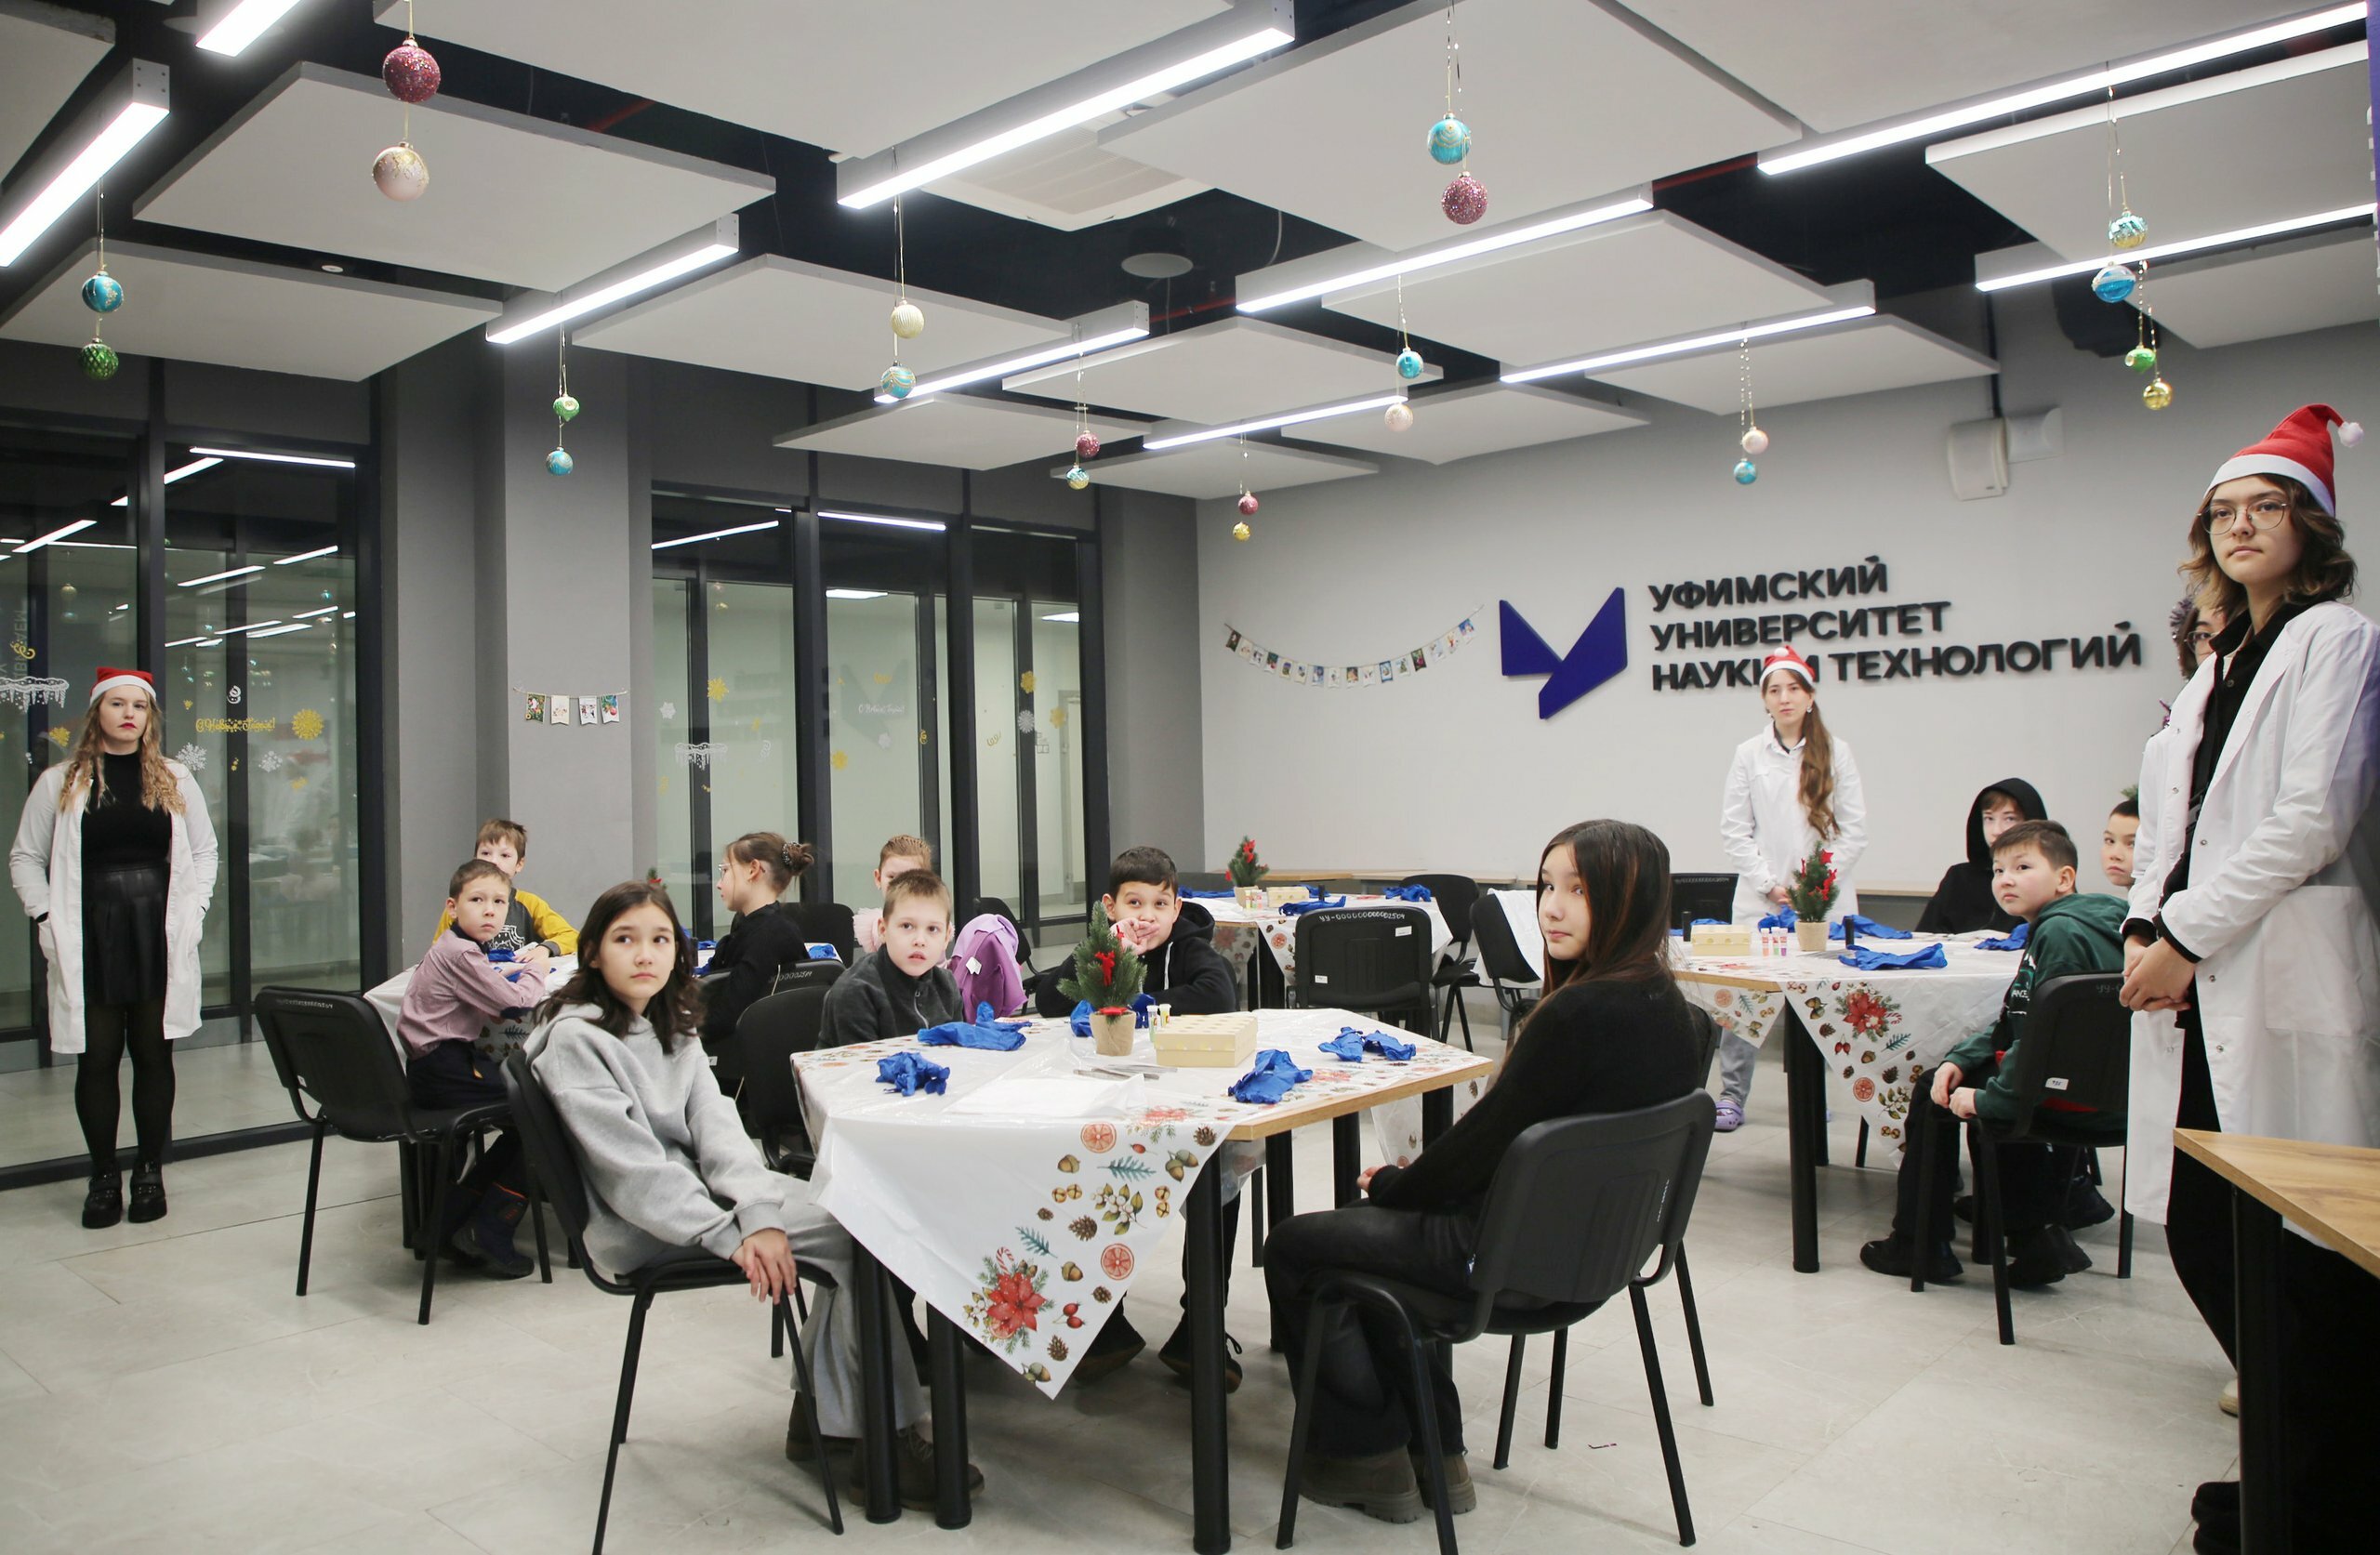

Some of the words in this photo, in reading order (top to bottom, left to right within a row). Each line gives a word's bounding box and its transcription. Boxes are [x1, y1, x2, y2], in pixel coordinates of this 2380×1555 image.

[1648, 555, 1888, 613] УФИМСКИЙ
[1650, 600, 1951, 652] УНИВЕРСИТЕТ
[1829, 621, 2142, 682] ТЕХНОЛОГИЙ
